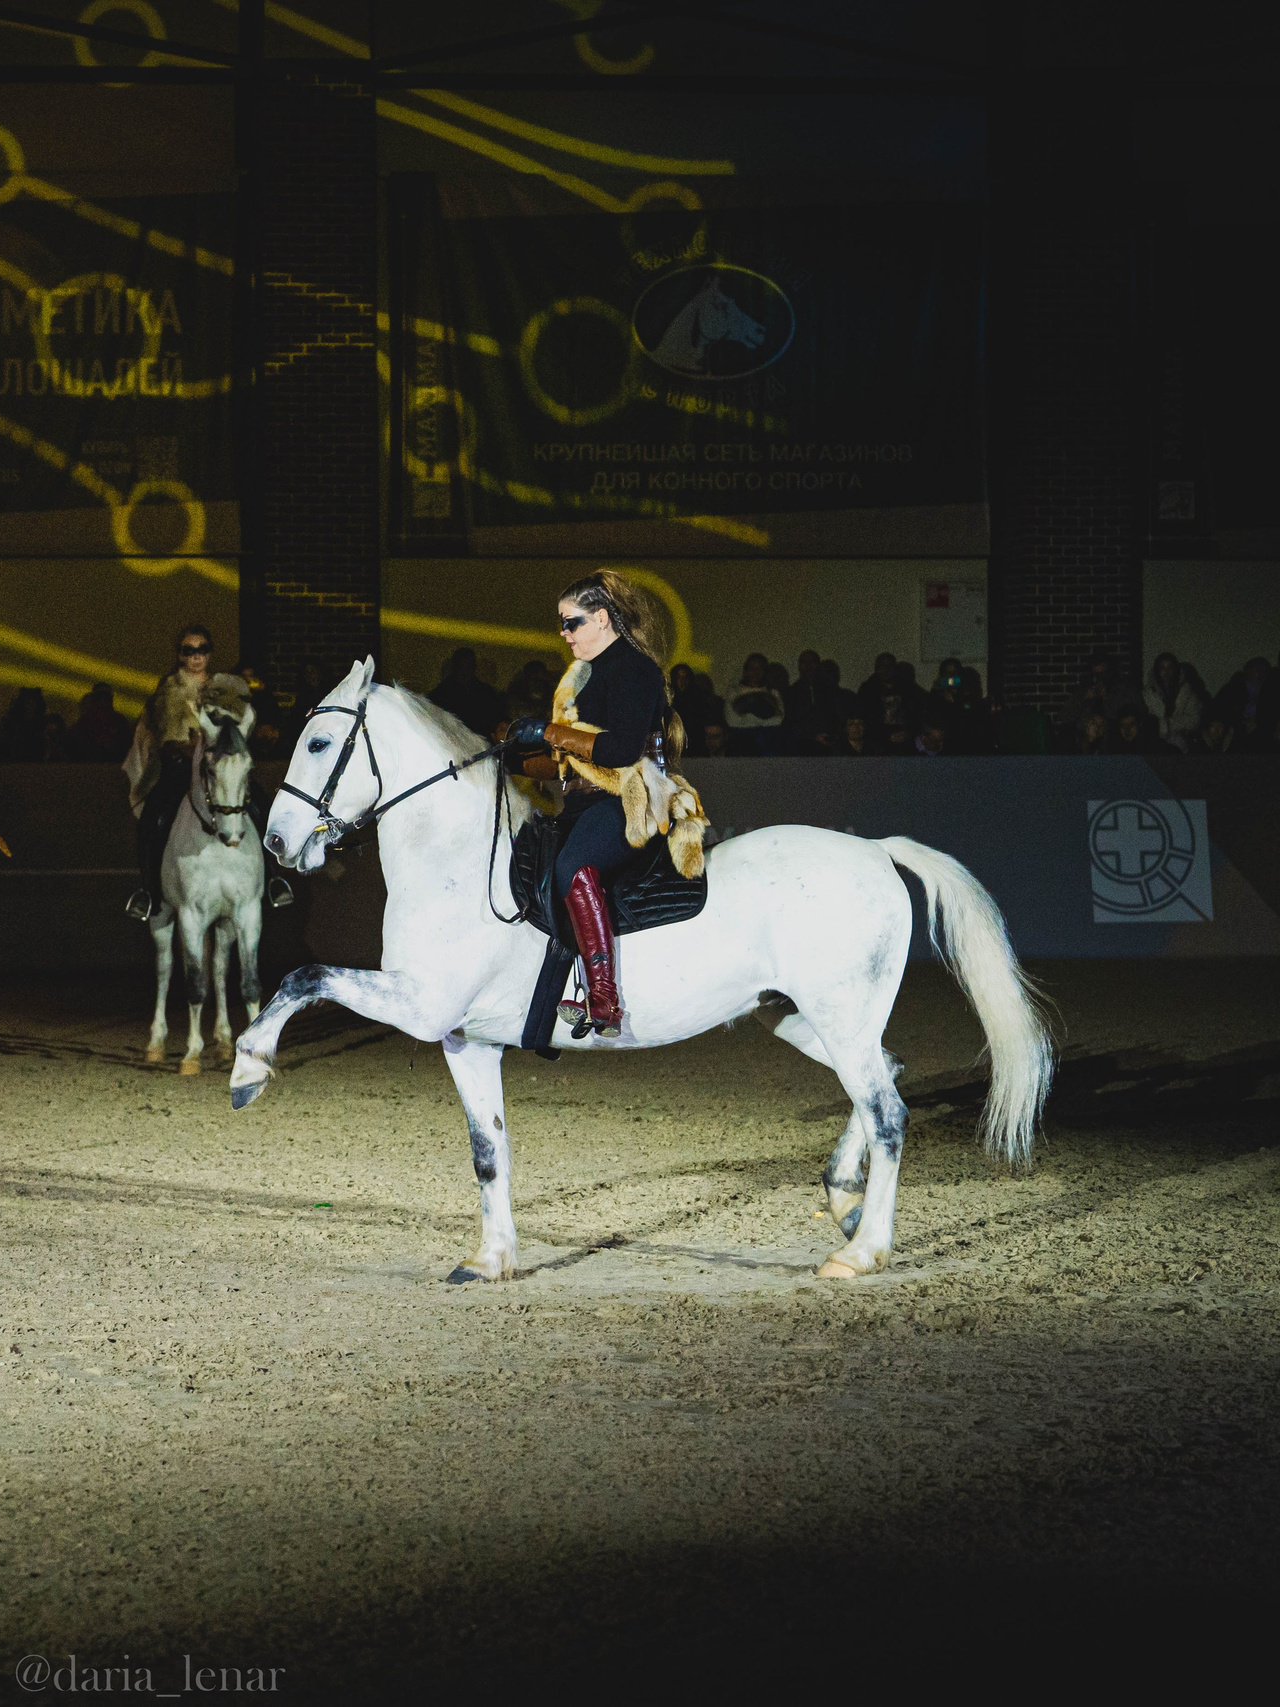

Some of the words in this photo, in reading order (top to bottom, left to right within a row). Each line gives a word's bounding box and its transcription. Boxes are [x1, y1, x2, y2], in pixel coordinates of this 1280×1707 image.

[532, 440, 697, 463] КРУПНЕЙШАЯ
[702, 442, 763, 463] СЕТЬ
[768, 442, 914, 463] МАГАЗИНОВ
[590, 470, 642, 494] ДЛЯ
[647, 470, 763, 491] КОННОГО
[768, 470, 864, 491] СПОРТА
